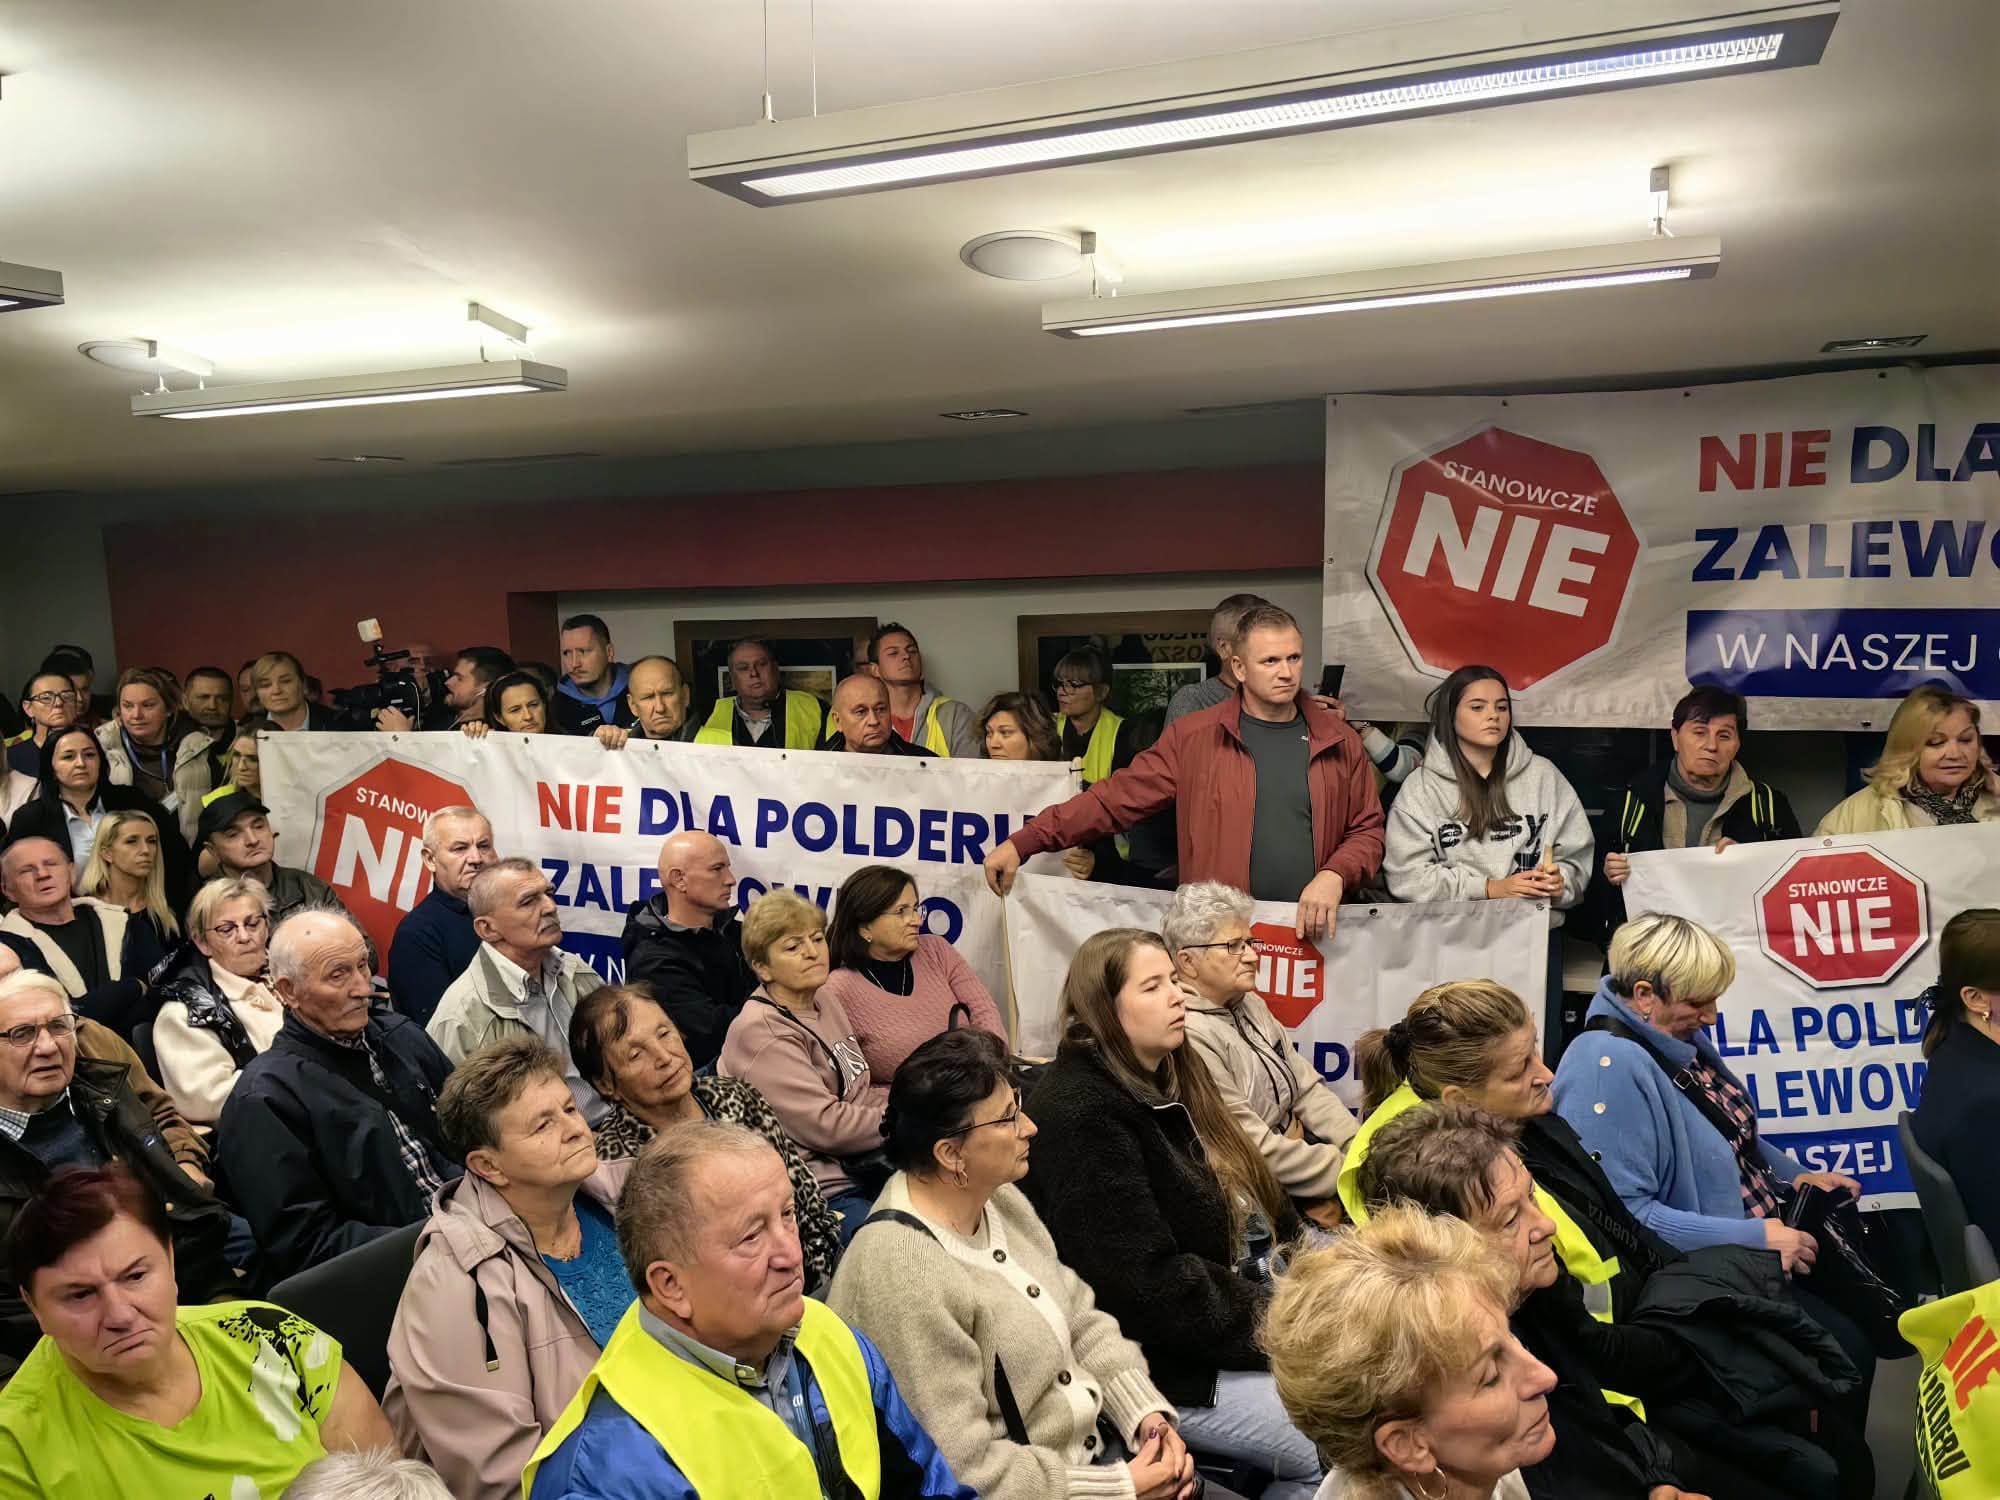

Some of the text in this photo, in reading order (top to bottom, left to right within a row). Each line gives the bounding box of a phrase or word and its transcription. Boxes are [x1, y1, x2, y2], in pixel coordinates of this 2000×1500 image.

[1699, 422, 2000, 492] NIE DLA
[1443, 461, 1599, 516] STANOWCZE
[1402, 491, 1611, 617] NIE
[1692, 519, 2000, 582] ZALEW
[1716, 633, 1978, 671] W NASZEJ
[537, 782, 623, 834] NIE
[638, 788, 742, 846] DLA
[332, 813, 433, 912] NI
[1788, 876, 1889, 898] STANOWCZE
[1790, 896, 1896, 957] NIE
[1703, 1009, 1780, 1057] LA
